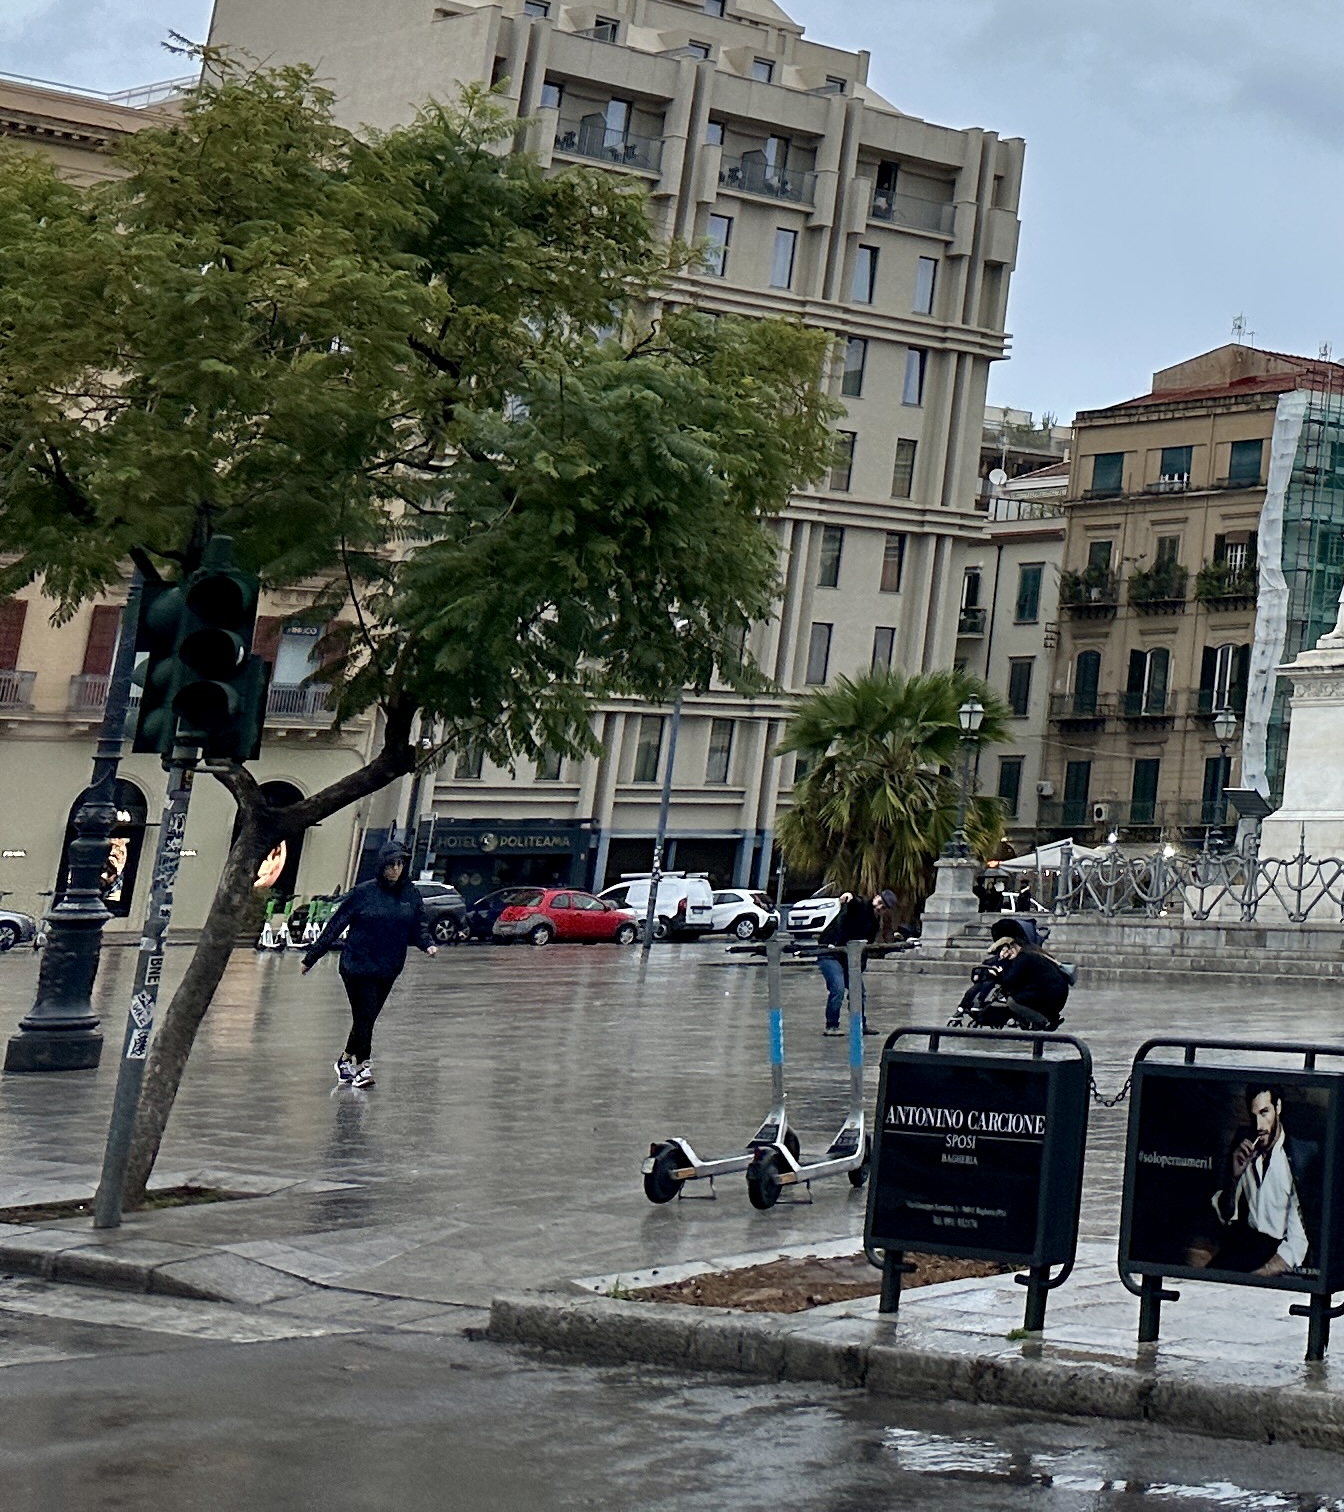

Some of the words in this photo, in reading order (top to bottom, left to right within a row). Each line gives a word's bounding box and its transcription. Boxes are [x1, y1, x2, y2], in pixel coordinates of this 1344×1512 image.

[438, 836, 477, 848] HOTEL
[500, 835, 570, 848] POLITEAMA
[885, 1105, 964, 1129] ANTONINO
[967, 1110, 1046, 1135] CARCIONE
[945, 1134, 977, 1149] SPOSI
